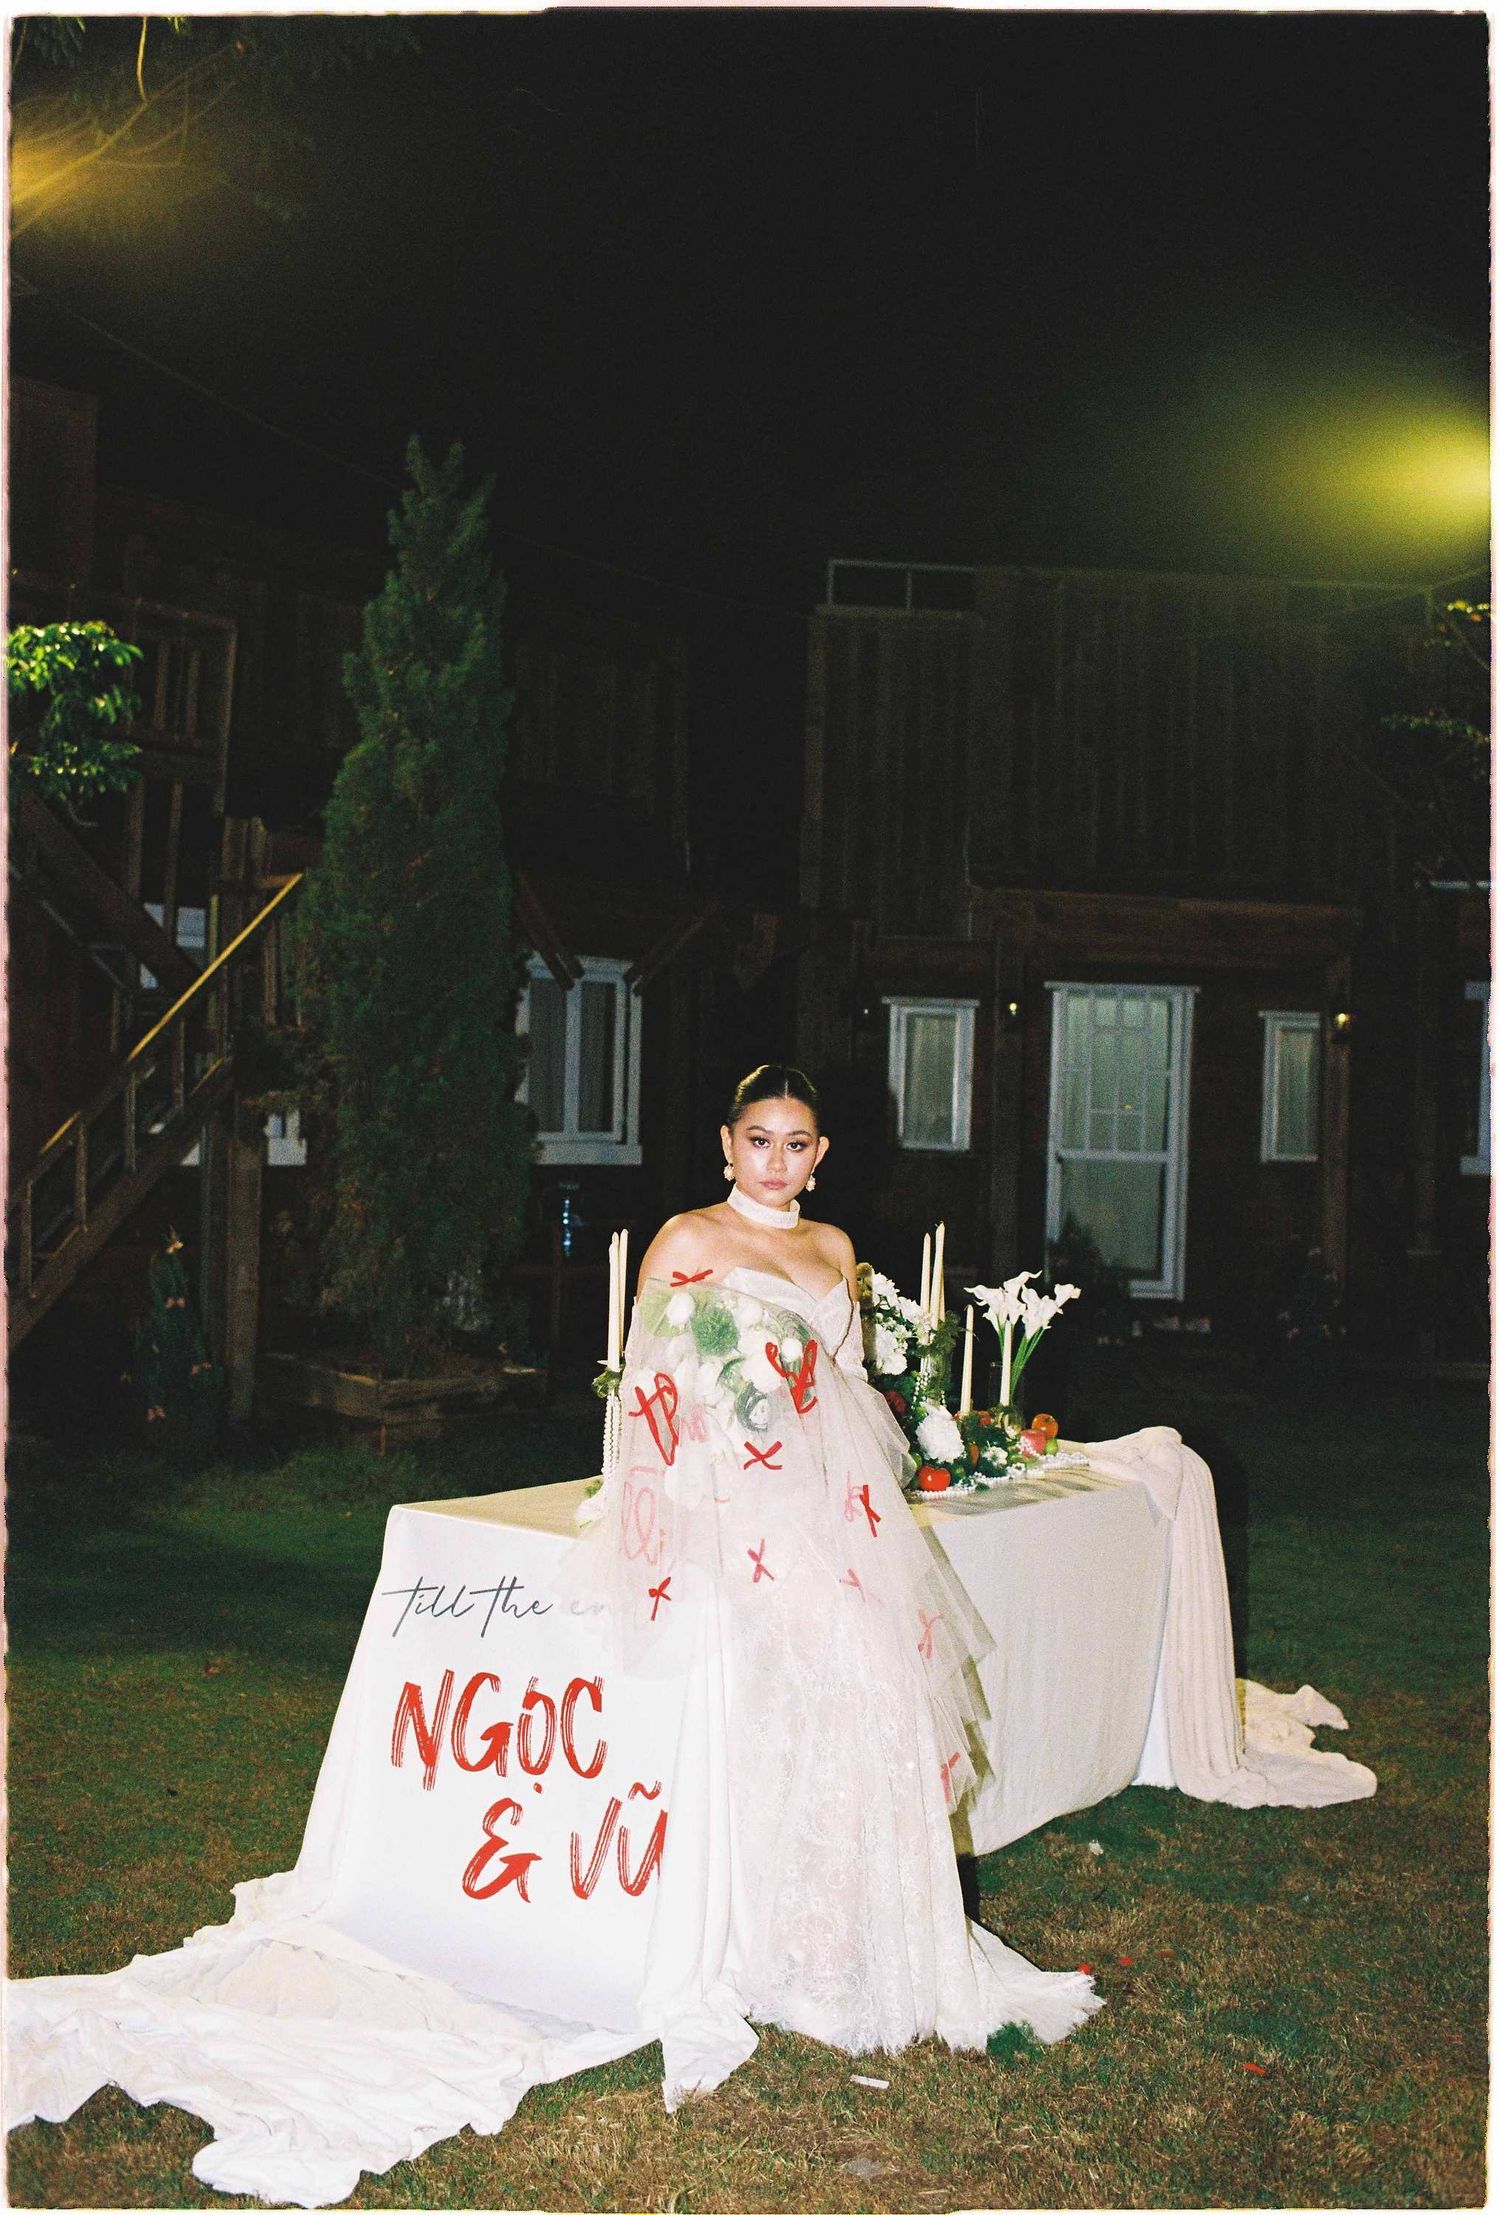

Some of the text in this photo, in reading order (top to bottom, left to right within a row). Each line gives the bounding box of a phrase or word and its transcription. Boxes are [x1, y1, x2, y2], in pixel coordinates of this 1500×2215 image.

[391, 1669, 608, 1794] NGỌC
[462, 1780, 669, 1903] & VŨ
